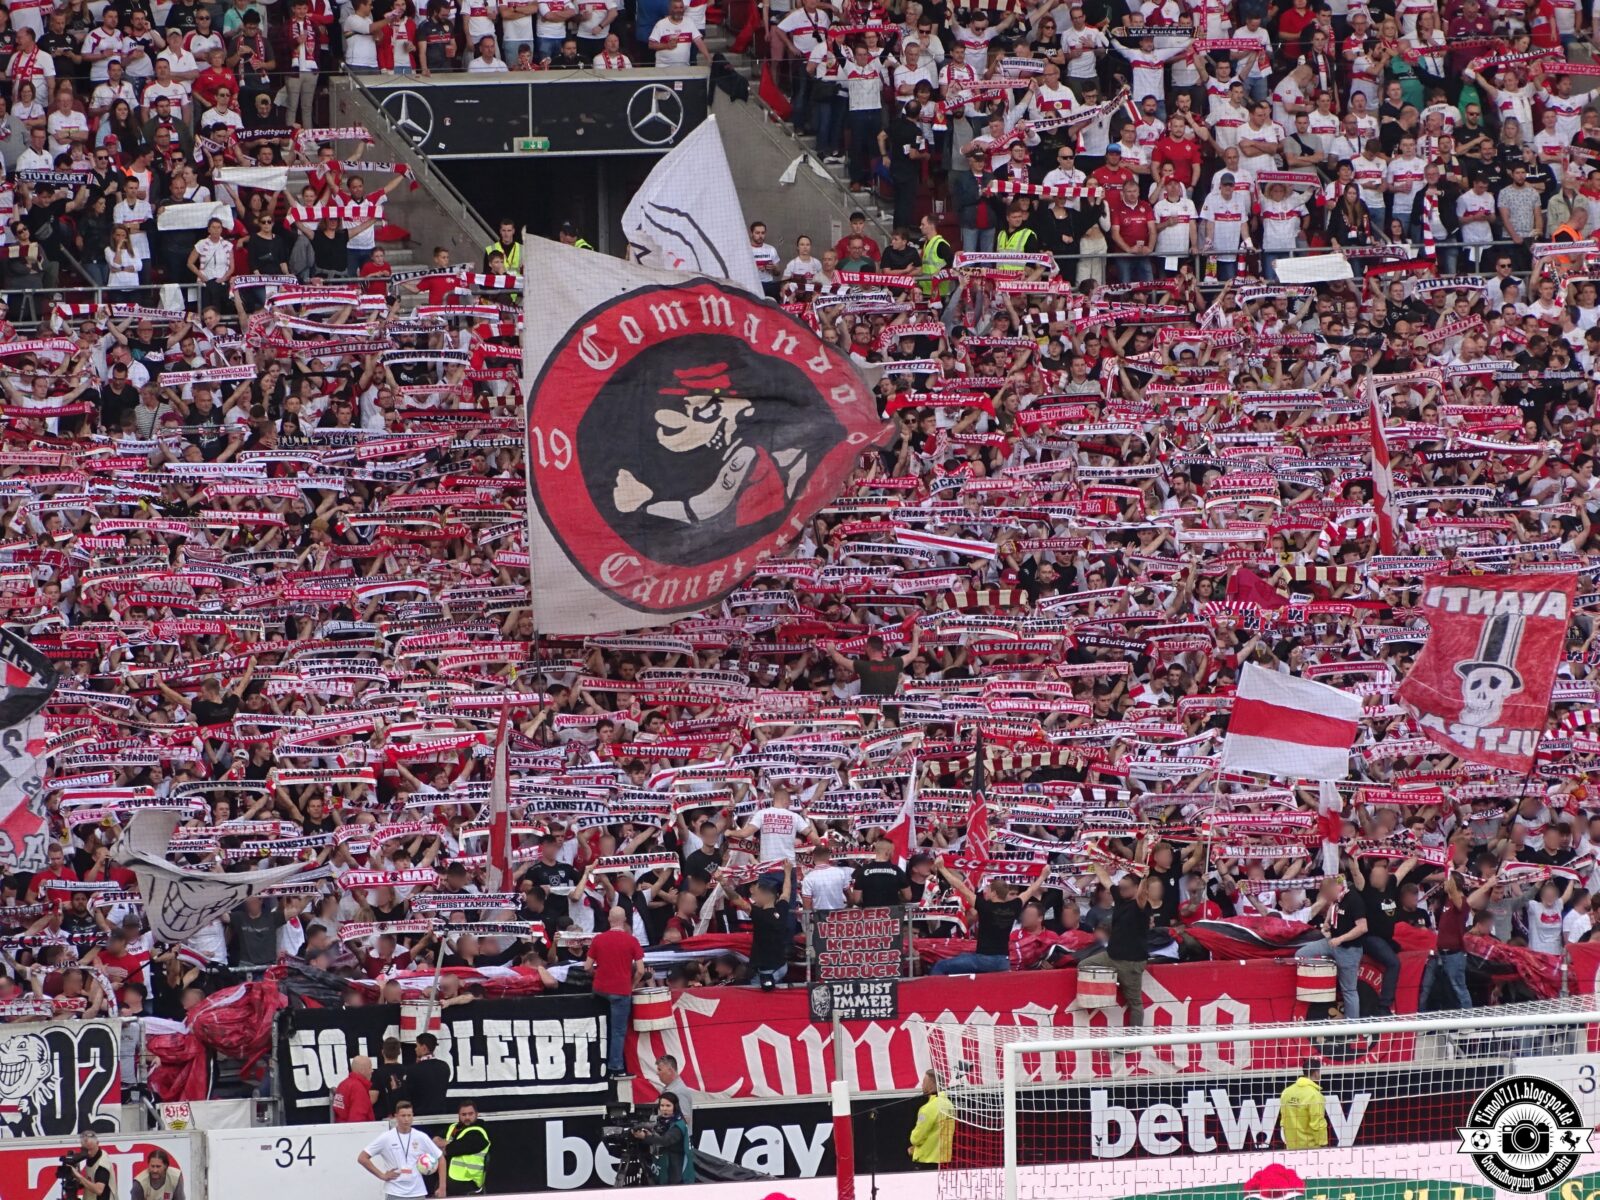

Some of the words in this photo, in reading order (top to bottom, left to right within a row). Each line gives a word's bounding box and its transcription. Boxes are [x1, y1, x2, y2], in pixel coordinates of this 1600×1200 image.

[19, 172, 85, 182] STUTTGART
[930, 393, 985, 402] Stuttgart
[1445, 451, 1488, 459] Stuttgart
[134, 474, 203, 482] STUTTGART
[96, 521, 158, 530] CANNSTATTER
[85, 565, 168, 578] CANNSTATTER
[823, 566, 890, 576] STUTTGART
[450, 589, 516, 598] STUTTGART
[1099, 637, 1146, 649] Stuttgart
[309, 667, 382, 677] STUTTGART
[910, 679, 989, 687] CANNSTATTER
[424, 707, 494, 719] STUTTGART
[421, 734, 477, 750] Stuttgart
[621, 747, 640, 756] VfB
[643, 747, 691, 757] STUTTGART
[284, 769, 361, 777] CANNSTATTER
[47, 773, 110, 788] Cannstatt
[118, 798, 192, 808] STUTTGART
[407, 794, 450, 803] NECKAR
[261, 833, 327, 849] CANNSTATT
[598, 853, 678, 866] CANNSTATTER
[955, 859, 979, 868] CC
[864, 868, 897, 876] Commando
[827, 908, 890, 922] JEDER
[818, 920, 900, 938] VERBANNTE
[826, 936, 893, 950] KEHRT
[821, 964, 900, 979] ZURÜCK
[833, 984, 853, 995] DU
[860, 983, 892, 995] BIST
[833, 995, 892, 1008] IMMER
[861, 1008, 894, 1019] UNS!
[40, 1022, 121, 1136] 02
[164, 1104, 189, 1118] VfB
[1090, 1088, 1372, 1158] betwy
[274, 1135, 316, 1169] 34
[546, 1119, 834, 1189] beway
